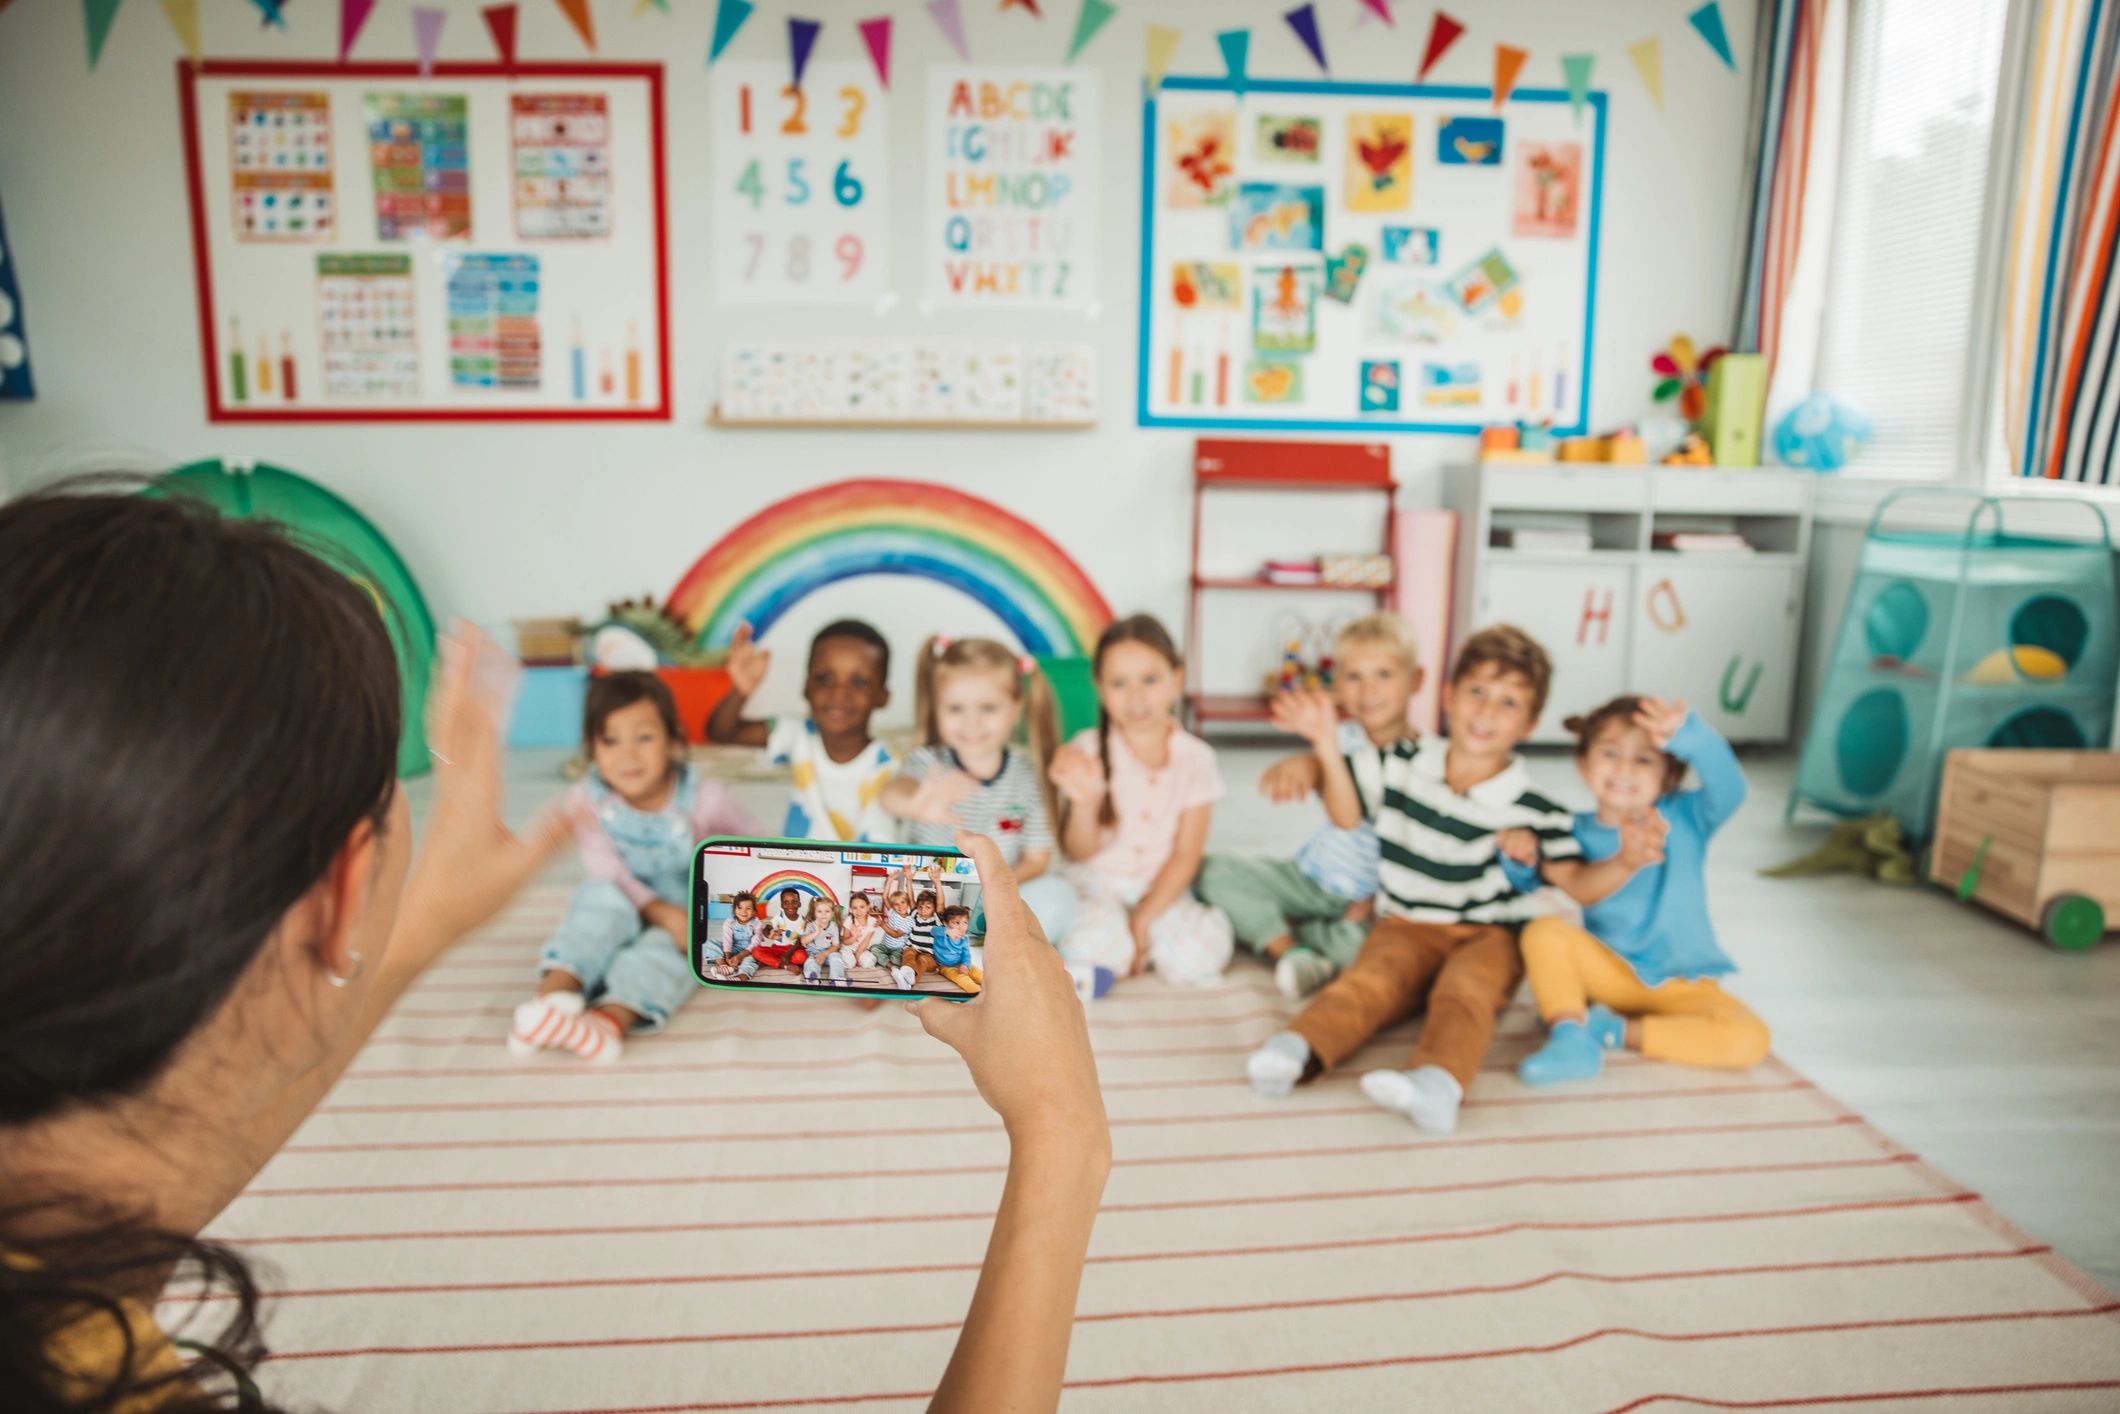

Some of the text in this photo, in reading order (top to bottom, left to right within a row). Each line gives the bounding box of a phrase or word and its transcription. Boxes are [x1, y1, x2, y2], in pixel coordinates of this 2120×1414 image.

[738, 84, 866, 137] 1 2 3
[735, 158, 863, 207] 4 5 6
[745, 235, 862, 281] 7 8 9
[1576, 586, 1613, 645] H
[1719, 654, 1763, 715] U
